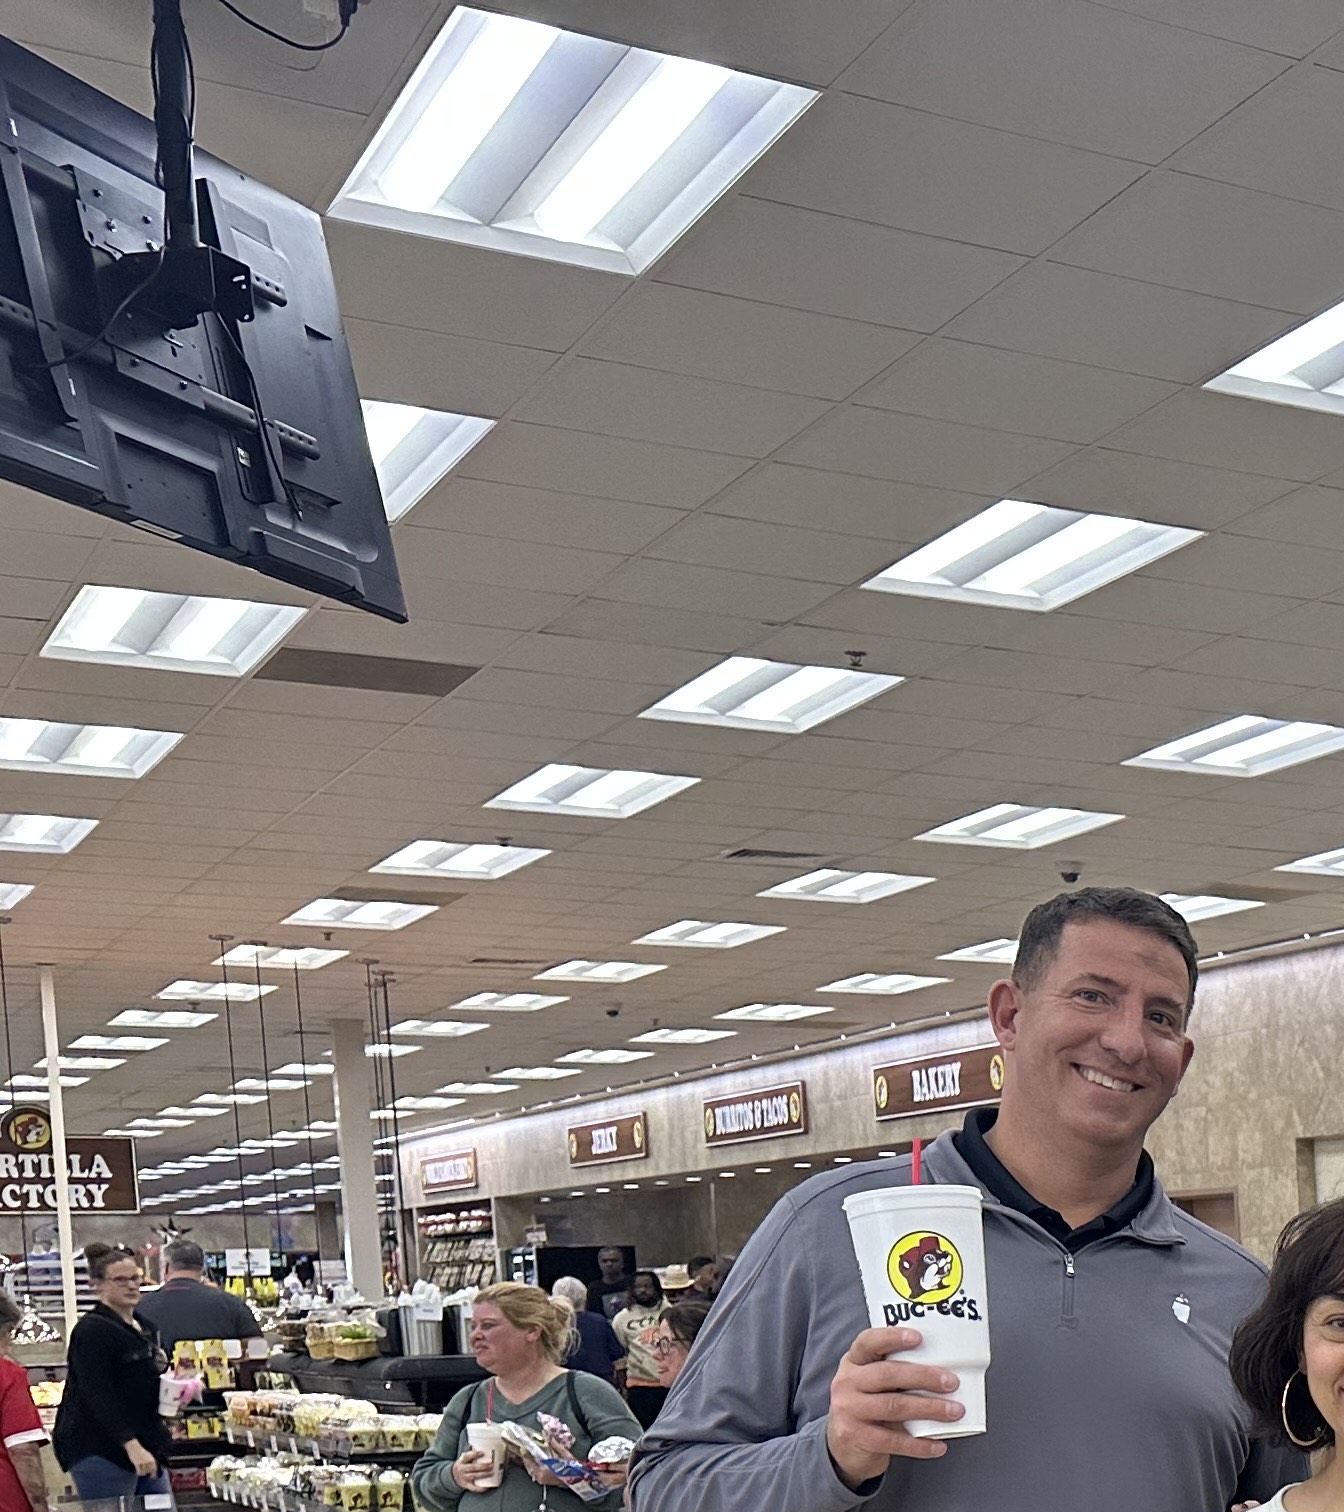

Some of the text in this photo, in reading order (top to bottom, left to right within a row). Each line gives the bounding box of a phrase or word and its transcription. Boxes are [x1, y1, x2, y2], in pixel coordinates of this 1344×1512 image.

[912, 1062, 961, 1102] BAKERY
[714, 1100, 754, 1135] BURRITOS
[762, 1094, 789, 1128] TACOS
[0, 1153, 113, 1179] RTILA
[0, 1183, 110, 1208] CTORY
